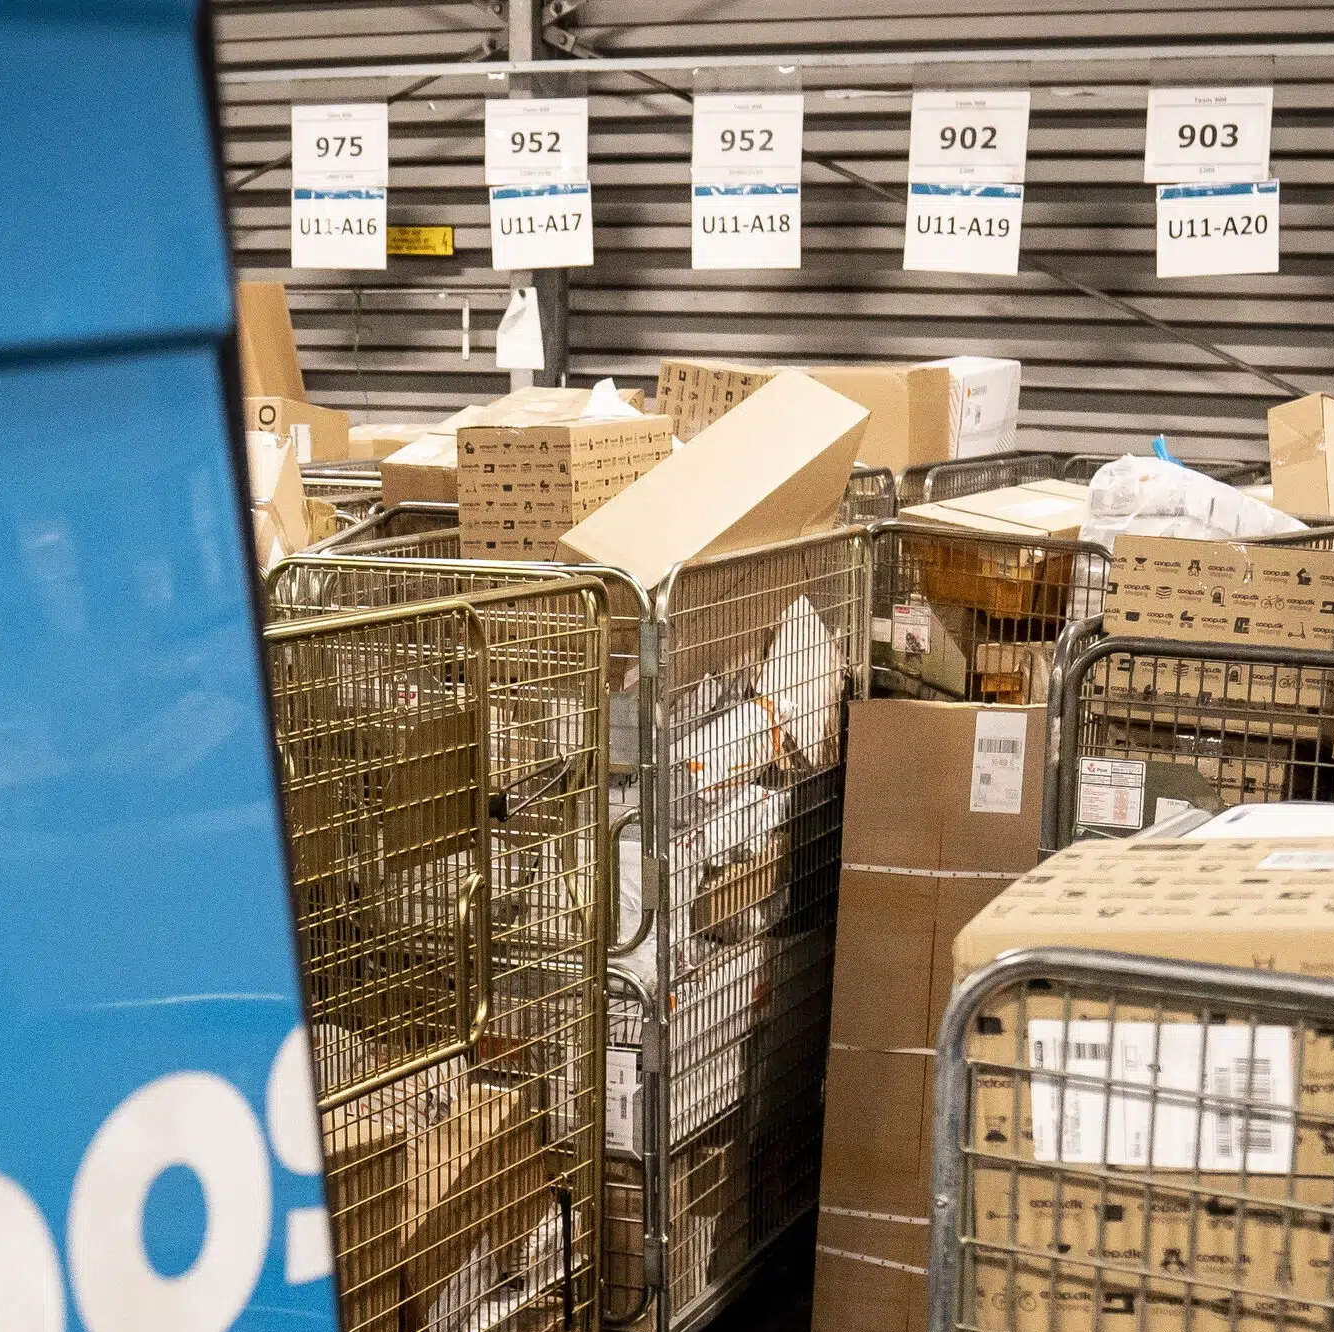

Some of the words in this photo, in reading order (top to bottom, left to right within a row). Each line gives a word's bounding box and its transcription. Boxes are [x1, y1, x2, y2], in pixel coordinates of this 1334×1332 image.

[511, 132, 560, 153] 952
[721, 130, 773, 151] 952
[941, 127, 996, 149] 902
[1179, 124, 1238, 148] 903
[316, 137, 362, 157] 975
[301, 219, 376, 234] U11-A16
[501, 214, 581, 235] U11-A17
[703, 215, 790, 233] U11-A18
[918, 216, 1009, 237] U11-A19
[1169, 215, 1267, 239] U11-A20
[1154, 561, 1181, 569] coop.dk
[1263, 569, 1290, 577] coop.dk
[1124, 584, 1151, 592] coop.dk
[1178, 588, 1205, 596] coop.dk
[1232, 593, 1259, 601] coop.dk
[1287, 598, 1316, 606] coop.dk
[1147, 611, 1174, 620] coop.dk
[1201, 616, 1228, 624] coop.dk
[1255, 621, 1283, 629] coop.dk
